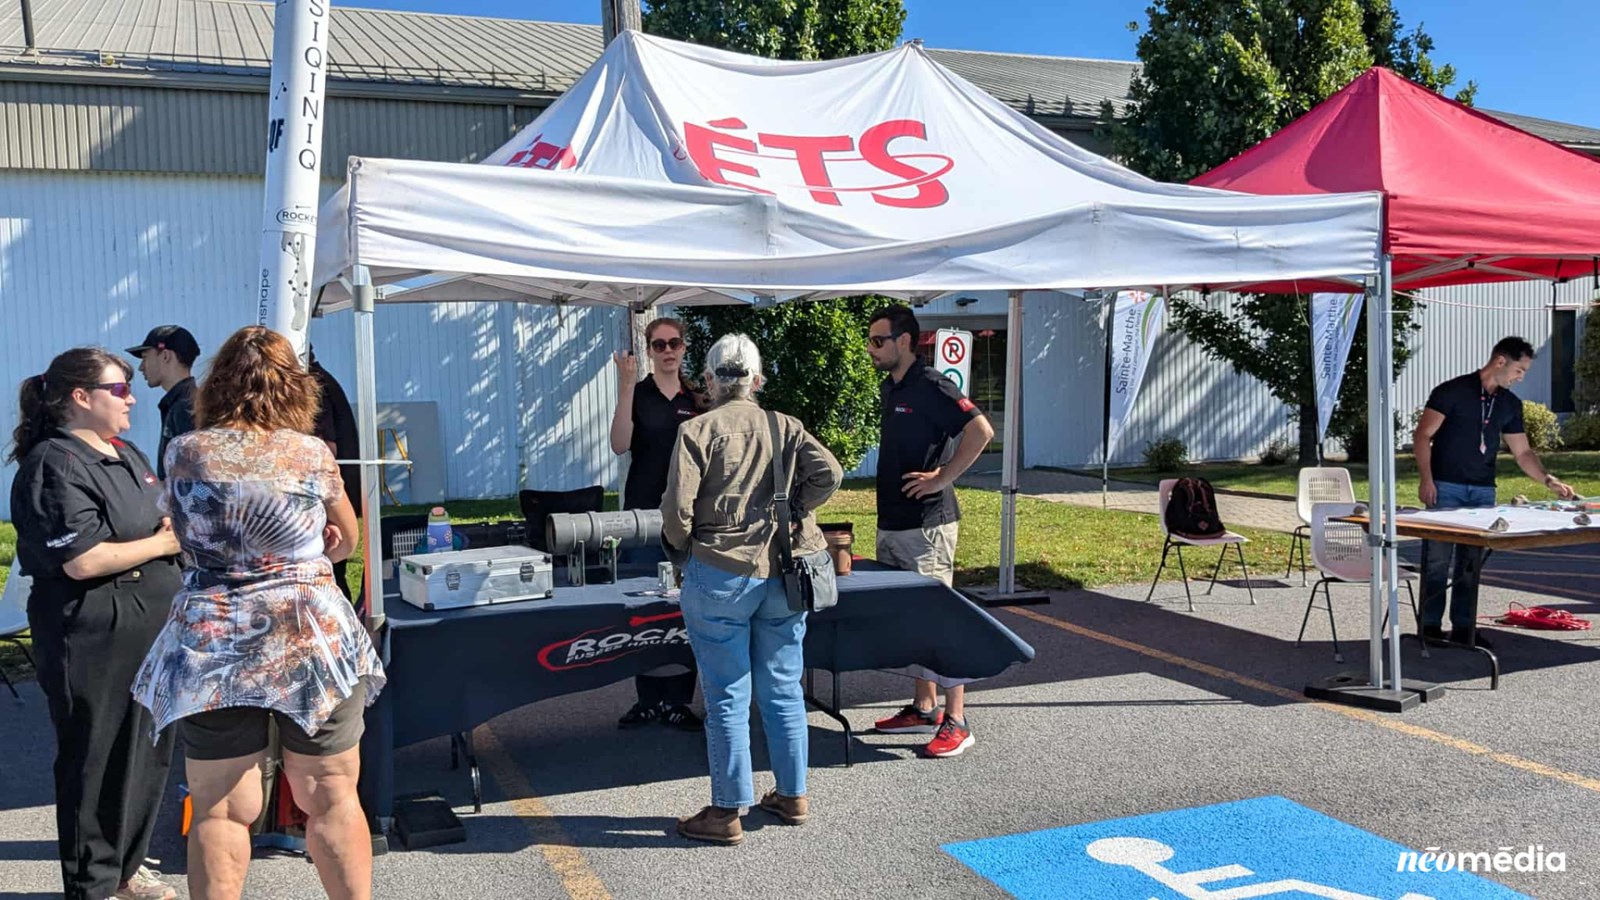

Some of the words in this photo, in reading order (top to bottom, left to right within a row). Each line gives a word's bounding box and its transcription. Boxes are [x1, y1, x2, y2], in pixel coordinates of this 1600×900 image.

[684, 117, 950, 208] ÉTS
[258, 268, 271, 326] nshape
[1116, 308, 1136, 394] Sainte-Marthe
[1321, 299, 1338, 379] Sainte-Marthe
[567, 627, 690, 657] ROCK
